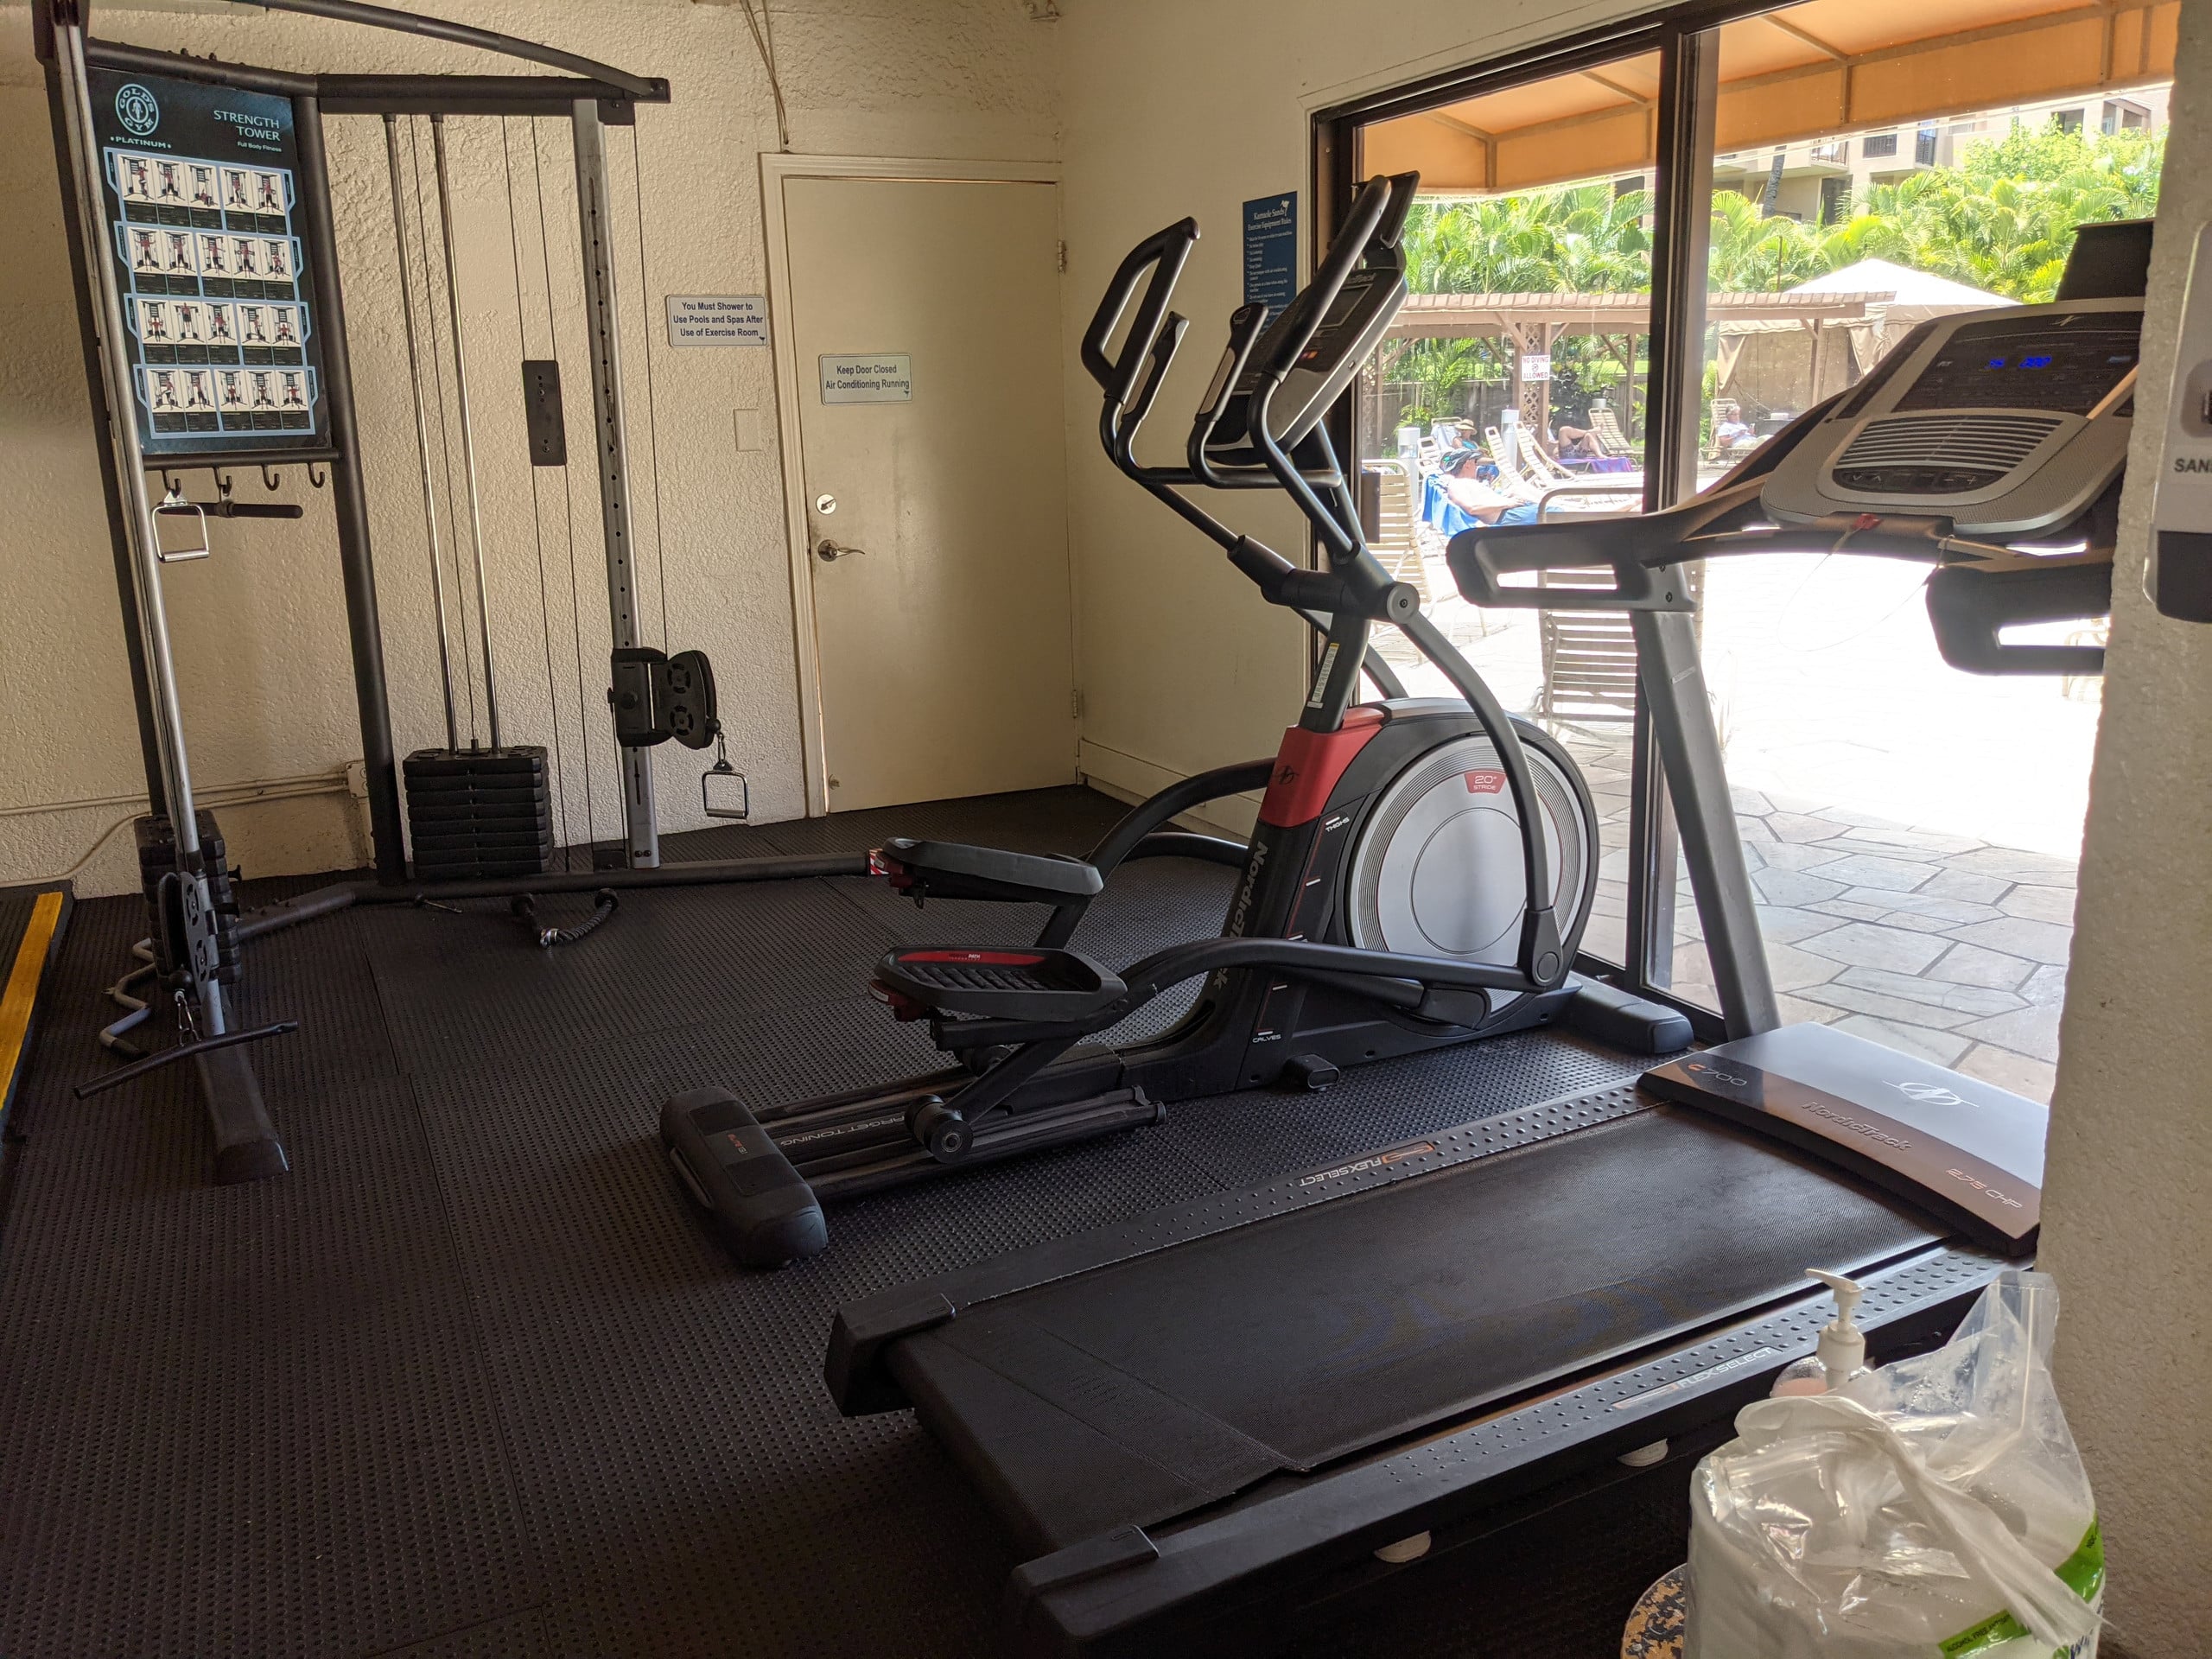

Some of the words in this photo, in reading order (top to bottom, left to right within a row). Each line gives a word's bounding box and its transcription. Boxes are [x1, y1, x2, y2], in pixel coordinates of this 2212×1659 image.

[118, 87, 155, 113] GOLD'S
[124, 117, 155, 131] GYM
[213, 110, 280, 130] STRENGTH
[236, 125, 281, 142] TOWER
[115, 136, 167, 149] PLATINUM
[247, 143, 263, 151] Body
[263, 144, 283, 153] Fitness
[681, 302, 696, 311] You
[697, 302, 715, 311] Must
[717, 302, 744, 311] Shower
[745, 302, 753, 311] to
[673, 315, 688, 324] Use
[689, 315, 709, 324] Pools
[711, 315, 725, 324] and
[726, 315, 744, 325] Spas
[746, 315, 764, 324] After
[680, 328, 695, 337] Use
[696, 327, 704, 337] of
[704, 328, 736, 337] Exercise
[737, 328, 759, 337] Room
[836, 365, 855, 377] Keep
[855, 365, 873, 374] Door
[874, 364, 898, 374] Closed
[825, 380, 836, 390] Air
[836, 378, 880, 391] Conditioning
[881, 378, 910, 390] Running
[1252, 1033, 1282, 1044] CALVES
[1801, 1101, 1916, 1153] NordicTrack
[780, 1130, 845, 1146] TONING
[1985, 1189, 2024, 1209] CHP
